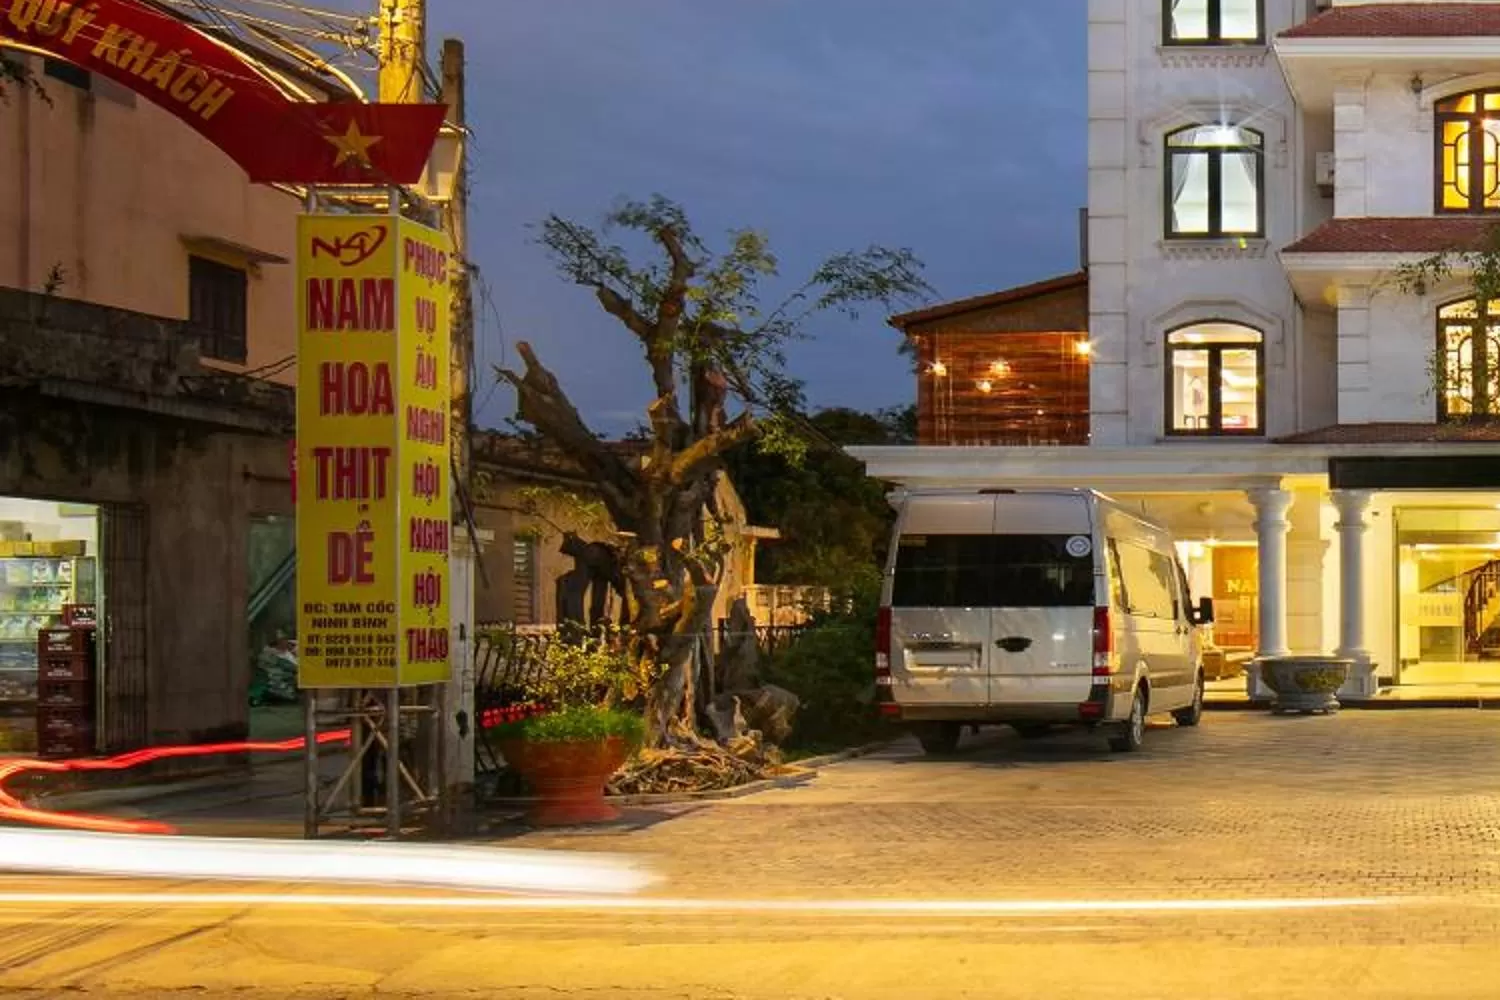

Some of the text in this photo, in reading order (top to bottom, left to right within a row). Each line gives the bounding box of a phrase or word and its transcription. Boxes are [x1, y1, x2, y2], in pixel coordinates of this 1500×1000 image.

[91, 23, 235, 121] KHÁCH
[404, 237, 447, 288] PHỤC
[307, 277, 395, 331] NAM
[320, 361, 395, 416] HOA
[313, 447, 392, 512] THỊT
